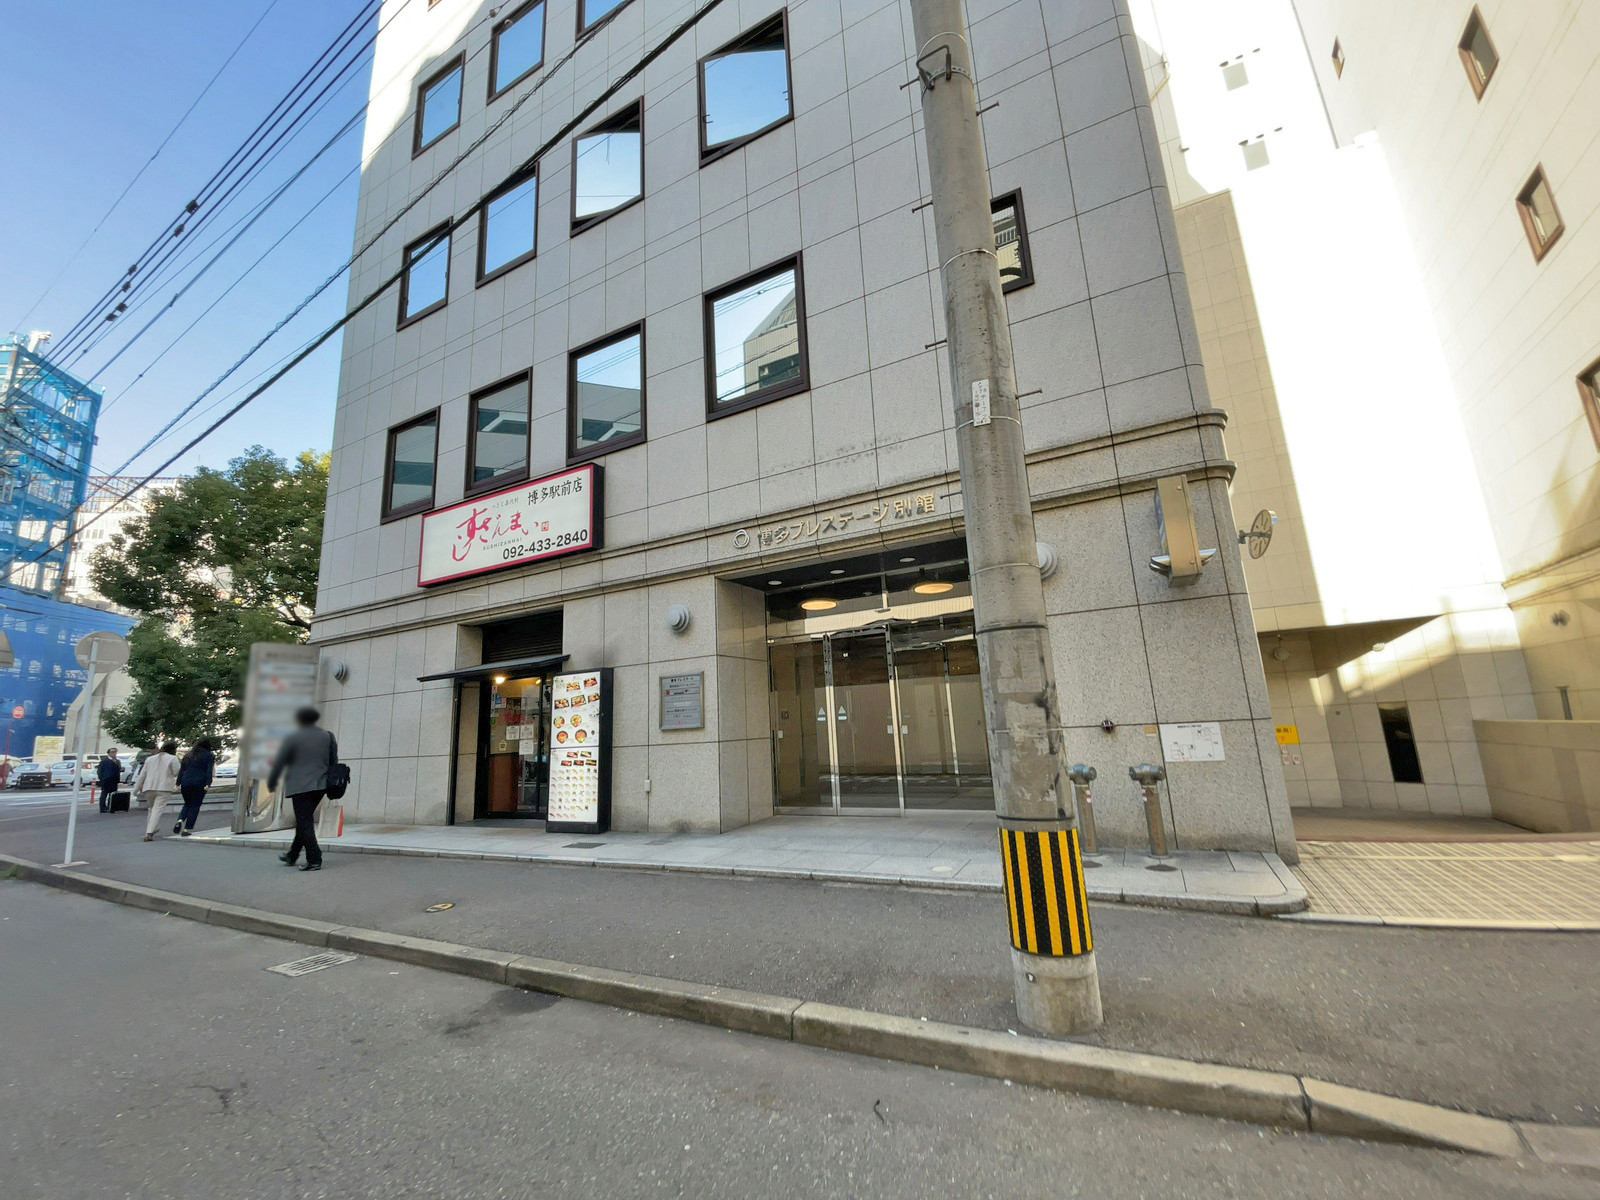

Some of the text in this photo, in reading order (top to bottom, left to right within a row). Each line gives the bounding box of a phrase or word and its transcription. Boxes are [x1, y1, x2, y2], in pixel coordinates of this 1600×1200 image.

[527, 477, 583, 506] 博多駅前店
[757, 494, 935, 547] 博多プレステージ別館
[482, 537, 523, 551] SUSHIZANMAI
[503, 529, 588, 560] 092-433-2840
